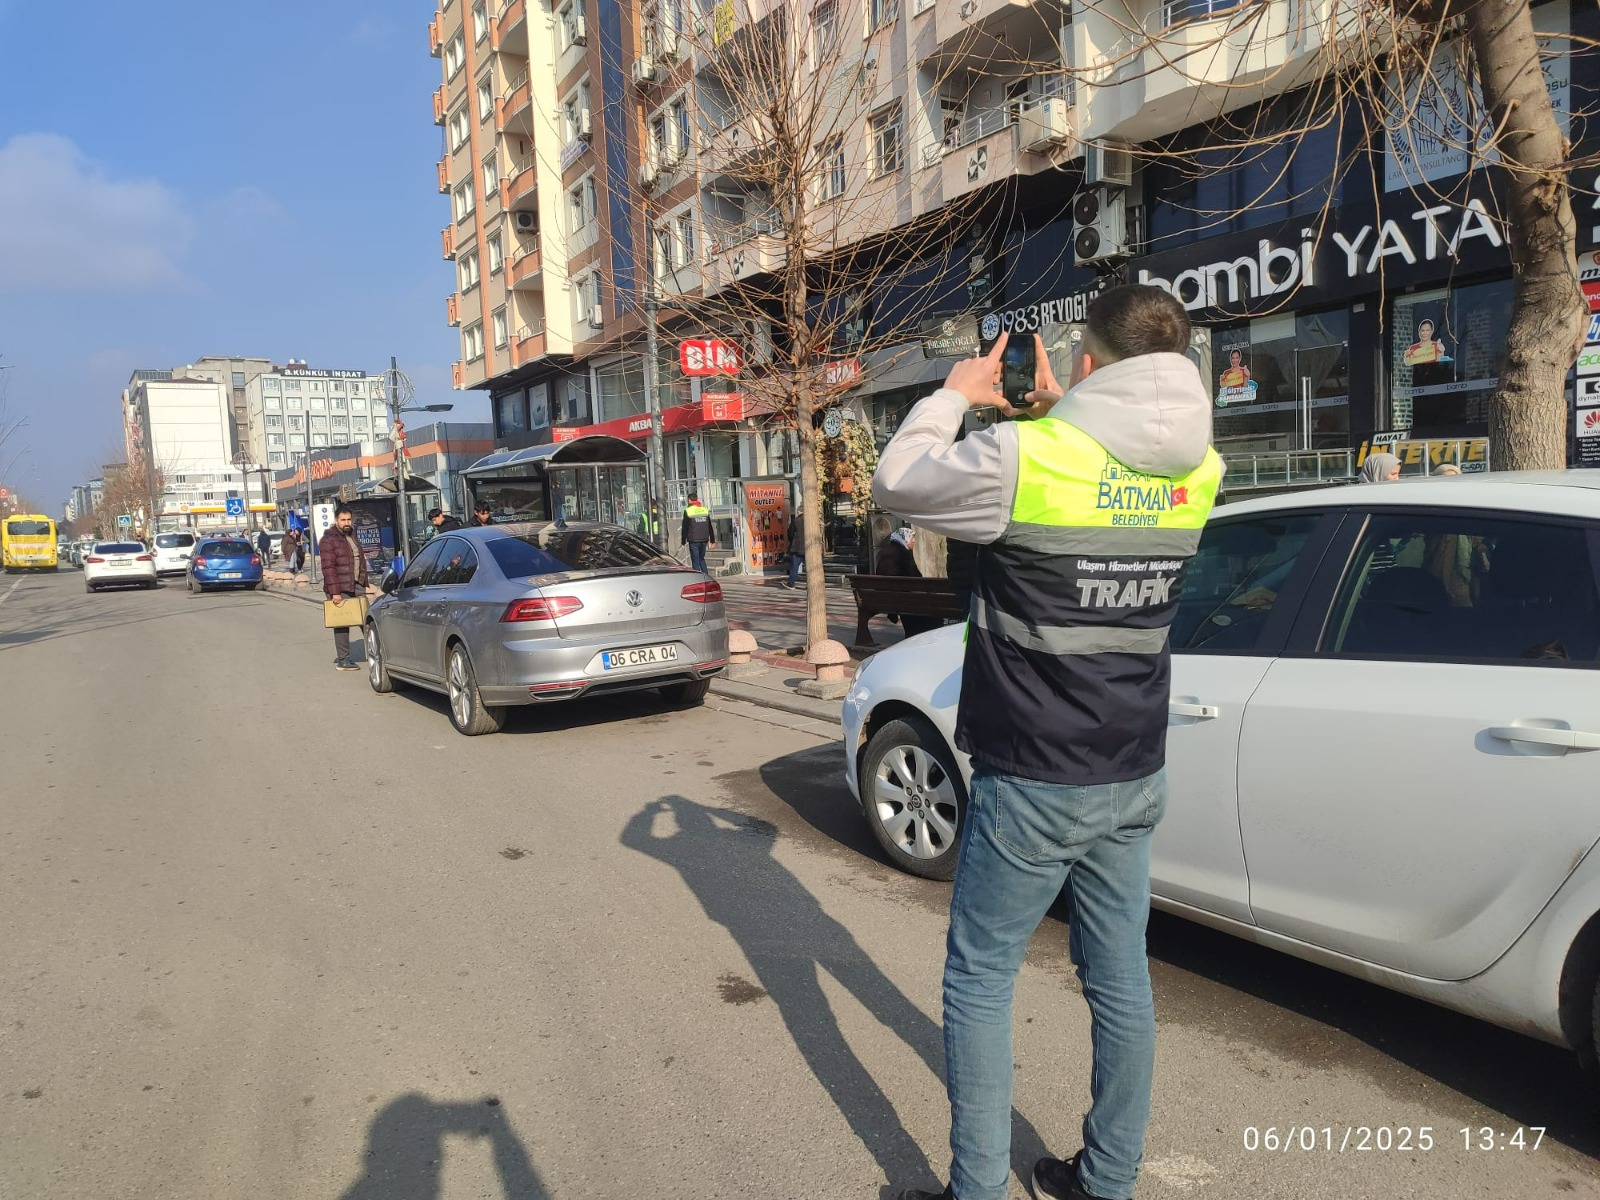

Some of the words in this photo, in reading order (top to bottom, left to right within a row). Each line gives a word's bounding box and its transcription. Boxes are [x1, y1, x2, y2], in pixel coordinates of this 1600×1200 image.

[1332, 198, 1512, 277] YATA
[999, 305, 1040, 335] 1983
[1041, 291, 1099, 327] BEYOĞL
[686, 340, 738, 370] BİM
[332, 370, 362, 378] İNŞAAT
[628, 416, 665, 433] AKBAK
[1375, 433, 1404, 443] HAYAT
[1096, 481, 1174, 511] BATMAN
[1112, 512, 1159, 527] BELEDİYESİ
[1077, 560, 1106, 573] Ulaşım
[1109, 560, 1148, 572] Hizmetleri
[1076, 571, 1177, 608] TRAFİK
[609, 652, 626, 667] 06
[629, 649, 657, 664] CRA
[661, 646, 676, 660] 04
